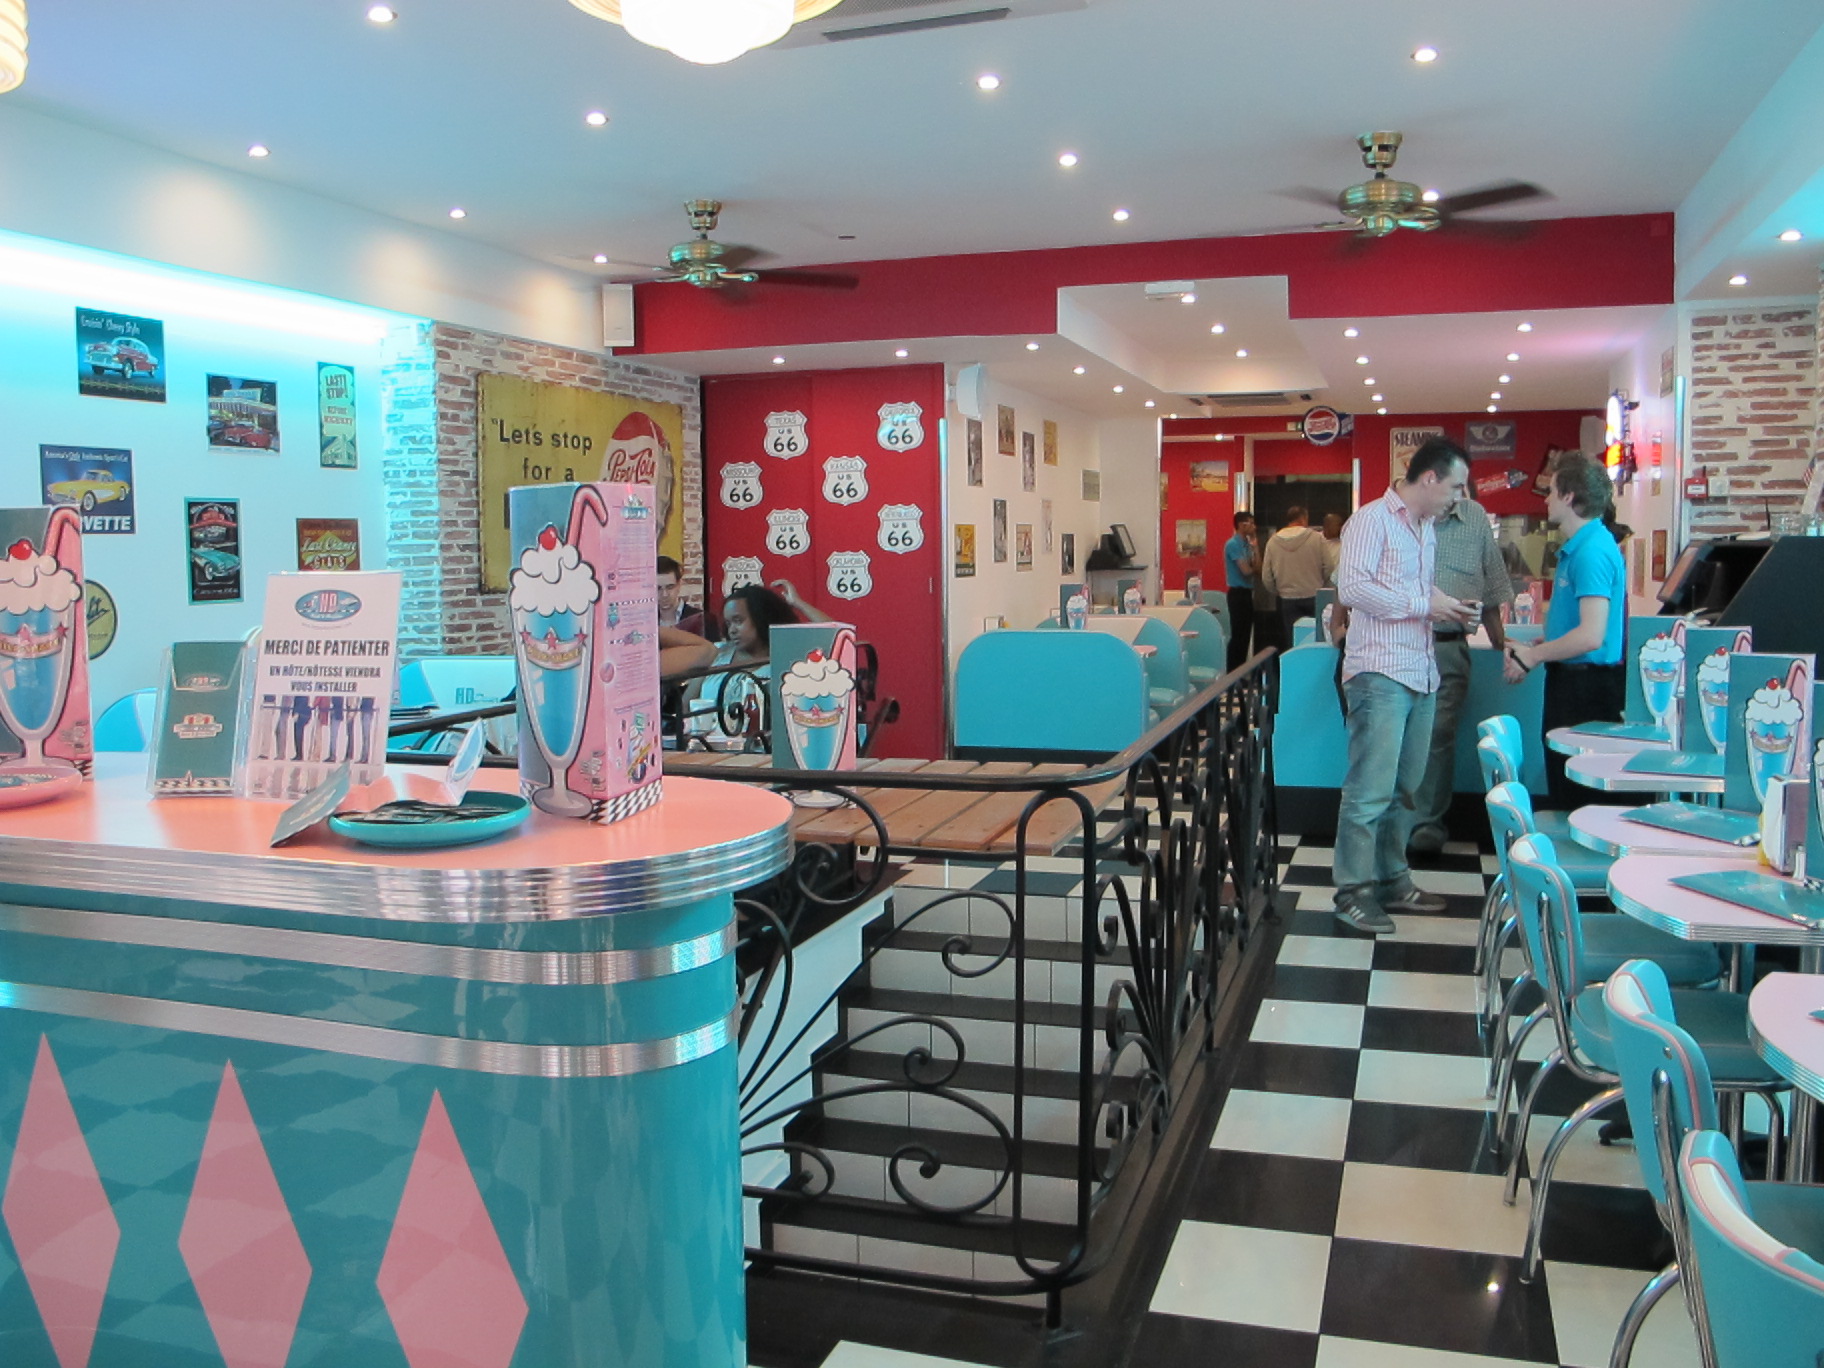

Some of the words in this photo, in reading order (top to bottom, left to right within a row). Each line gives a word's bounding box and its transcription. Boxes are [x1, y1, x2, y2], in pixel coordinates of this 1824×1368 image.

[774, 416, 796, 424] TEXAS
[551, 432, 592, 456] stop
[774, 436, 798, 452] 66
[887, 428, 914, 445] 66
[523, 456, 552, 480] for
[564, 467, 575, 481] a
[729, 486, 754, 503] 66
[832, 482, 858, 498] 66
[776, 534, 800, 550] 66
[887, 530, 913, 546] 66
[836, 576, 862, 593] 66
[264, 640, 304, 656] MERCI
[306, 640, 322, 656] DE
[323, 640, 390, 656] PATIENTER
[270, 665, 280, 677] UN
[345, 666, 381, 678] VIENDRA
[290, 681, 312, 692] VOUS
[313, 682, 357, 692] INSTALLER
